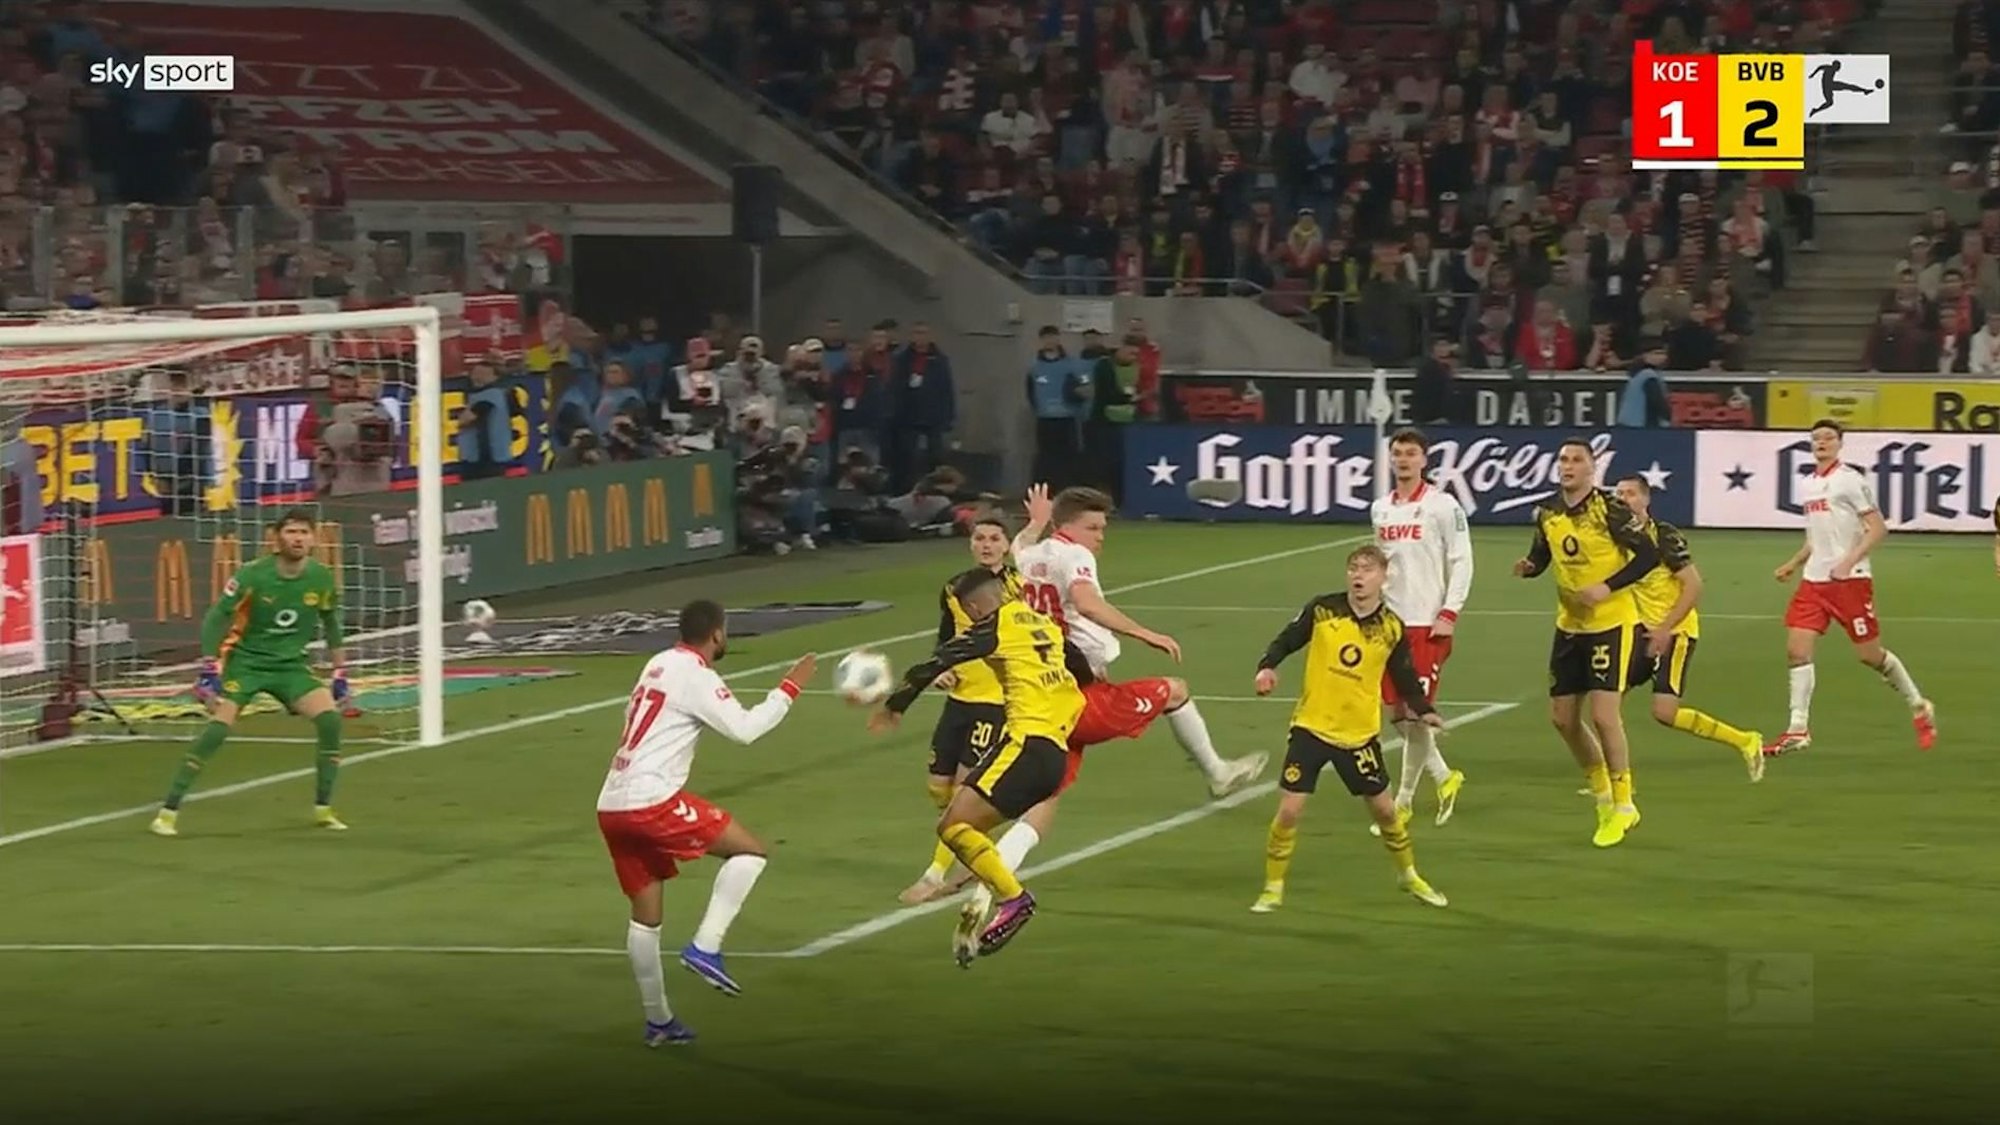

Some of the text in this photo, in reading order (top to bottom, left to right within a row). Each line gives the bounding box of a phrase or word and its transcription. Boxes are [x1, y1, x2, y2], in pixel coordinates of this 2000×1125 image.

[222, 94, 562, 123] FFZEH-
[266, 126, 620, 152] TROM
[1777, 440, 1992, 524] Gffel
[1379, 525, 1422, 540] REWE
[1853, 618, 1868, 636] 6
[1591, 645, 1611, 669] 25
[970, 721, 993, 748] 20
[1353, 748, 1379, 774] 24
